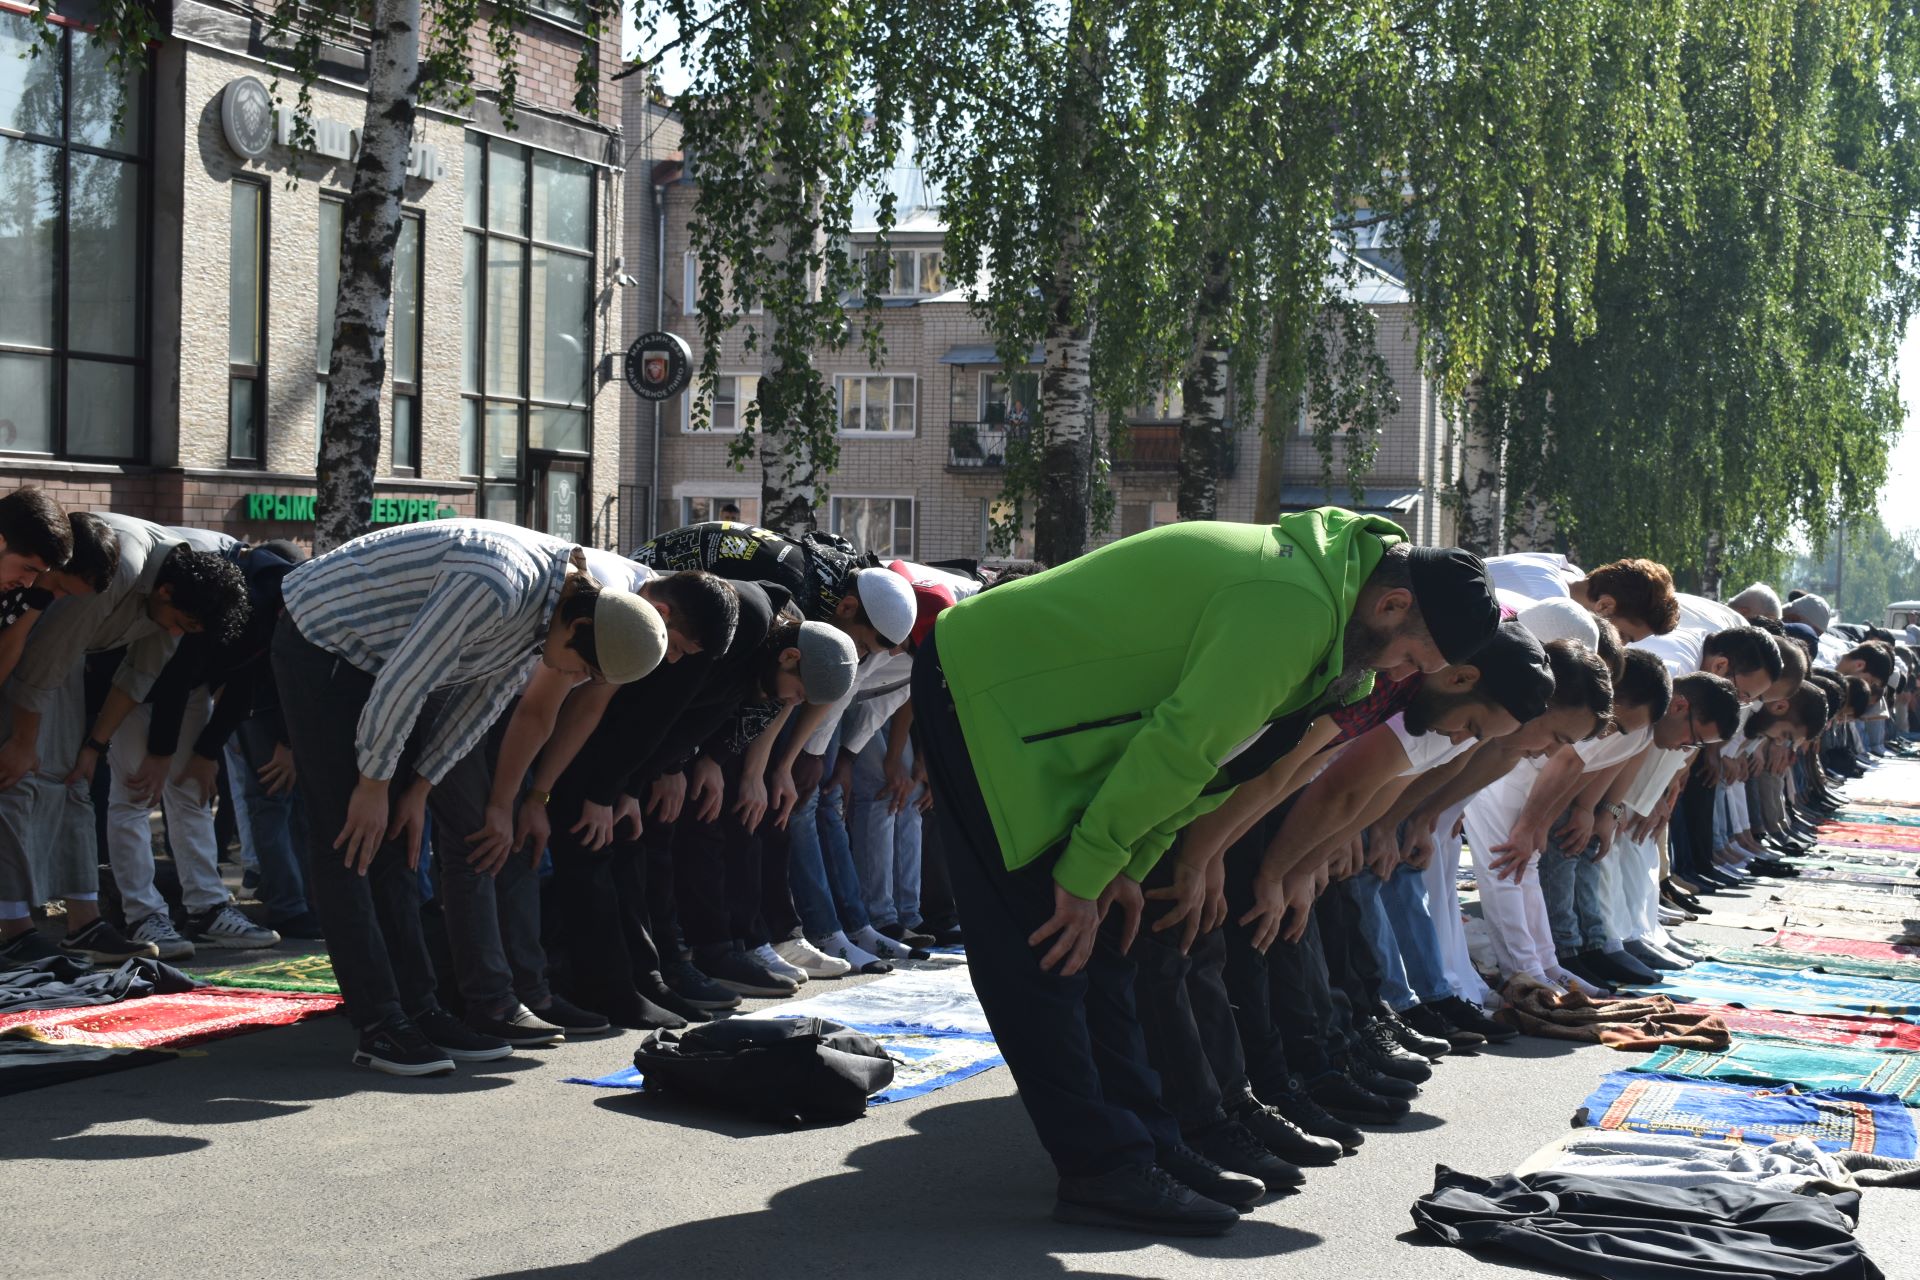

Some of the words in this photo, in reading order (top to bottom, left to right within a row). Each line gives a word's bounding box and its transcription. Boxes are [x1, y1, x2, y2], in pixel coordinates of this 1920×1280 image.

[630, 335, 684, 358] МАГАЗИН-БАР
[627, 367, 669, 398] РАЗЛИВНОЕ
[667, 367, 684, 393] ПИВО
